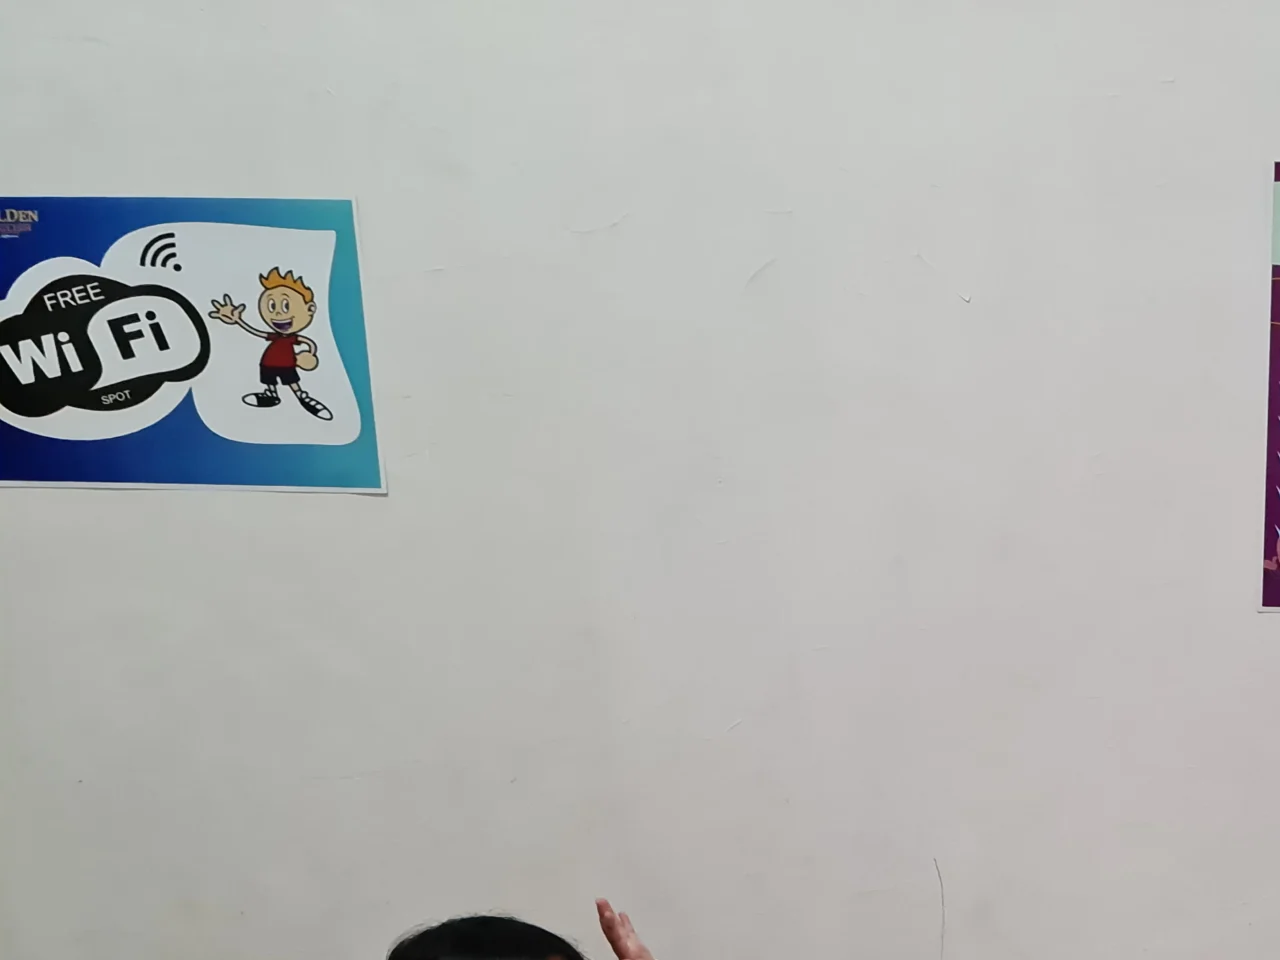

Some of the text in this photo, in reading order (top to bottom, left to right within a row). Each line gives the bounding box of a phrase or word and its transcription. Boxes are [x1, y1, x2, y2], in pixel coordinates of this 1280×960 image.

[43, 282, 105, 311] FREE
[0, 310, 170, 386] Wi Fi
[101, 389, 131, 406] SPOT
